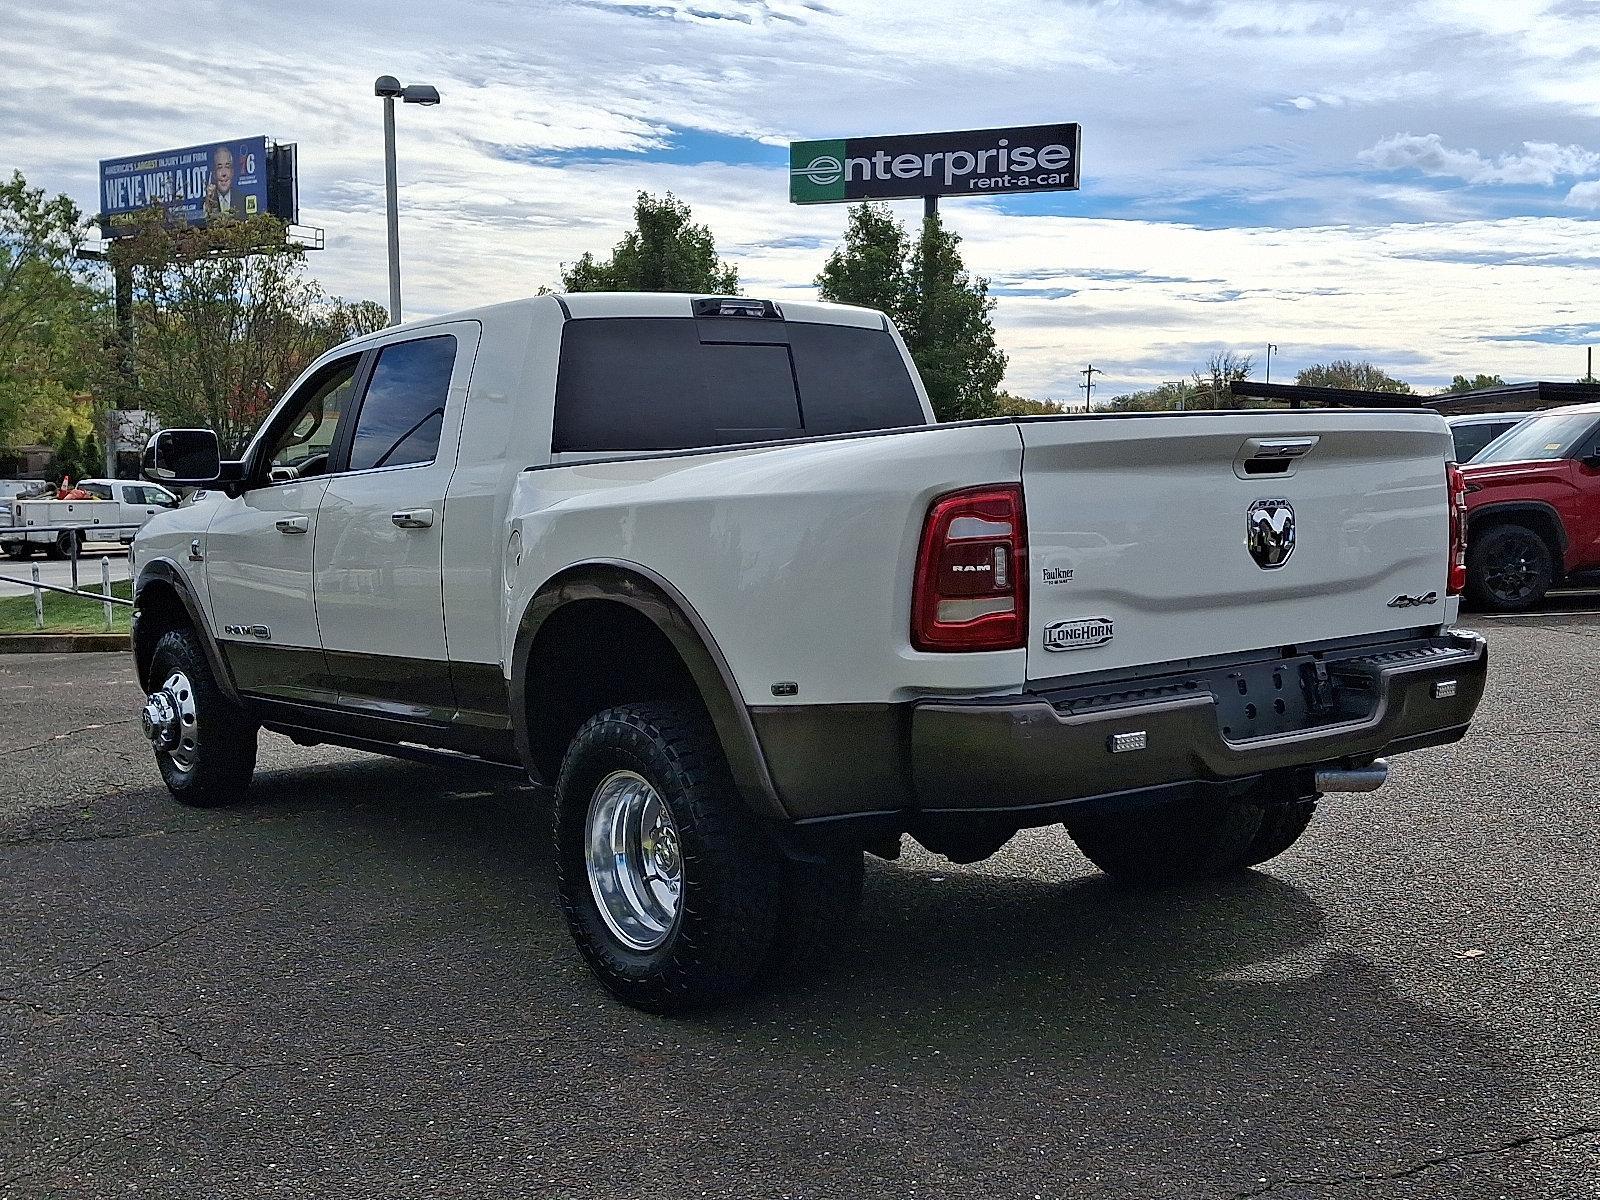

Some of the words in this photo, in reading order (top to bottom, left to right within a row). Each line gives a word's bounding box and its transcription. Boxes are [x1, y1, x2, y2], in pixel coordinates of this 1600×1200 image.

[791, 139, 1070, 185] enterprise
[106, 175, 142, 209] WE'VE
[144, 171, 173, 205] WON
[176, 170, 184, 200] A
[186, 166, 208, 199] LOT
[969, 172, 1069, 188] rent-a-car
[1043, 568, 1074, 581] Faulkner
